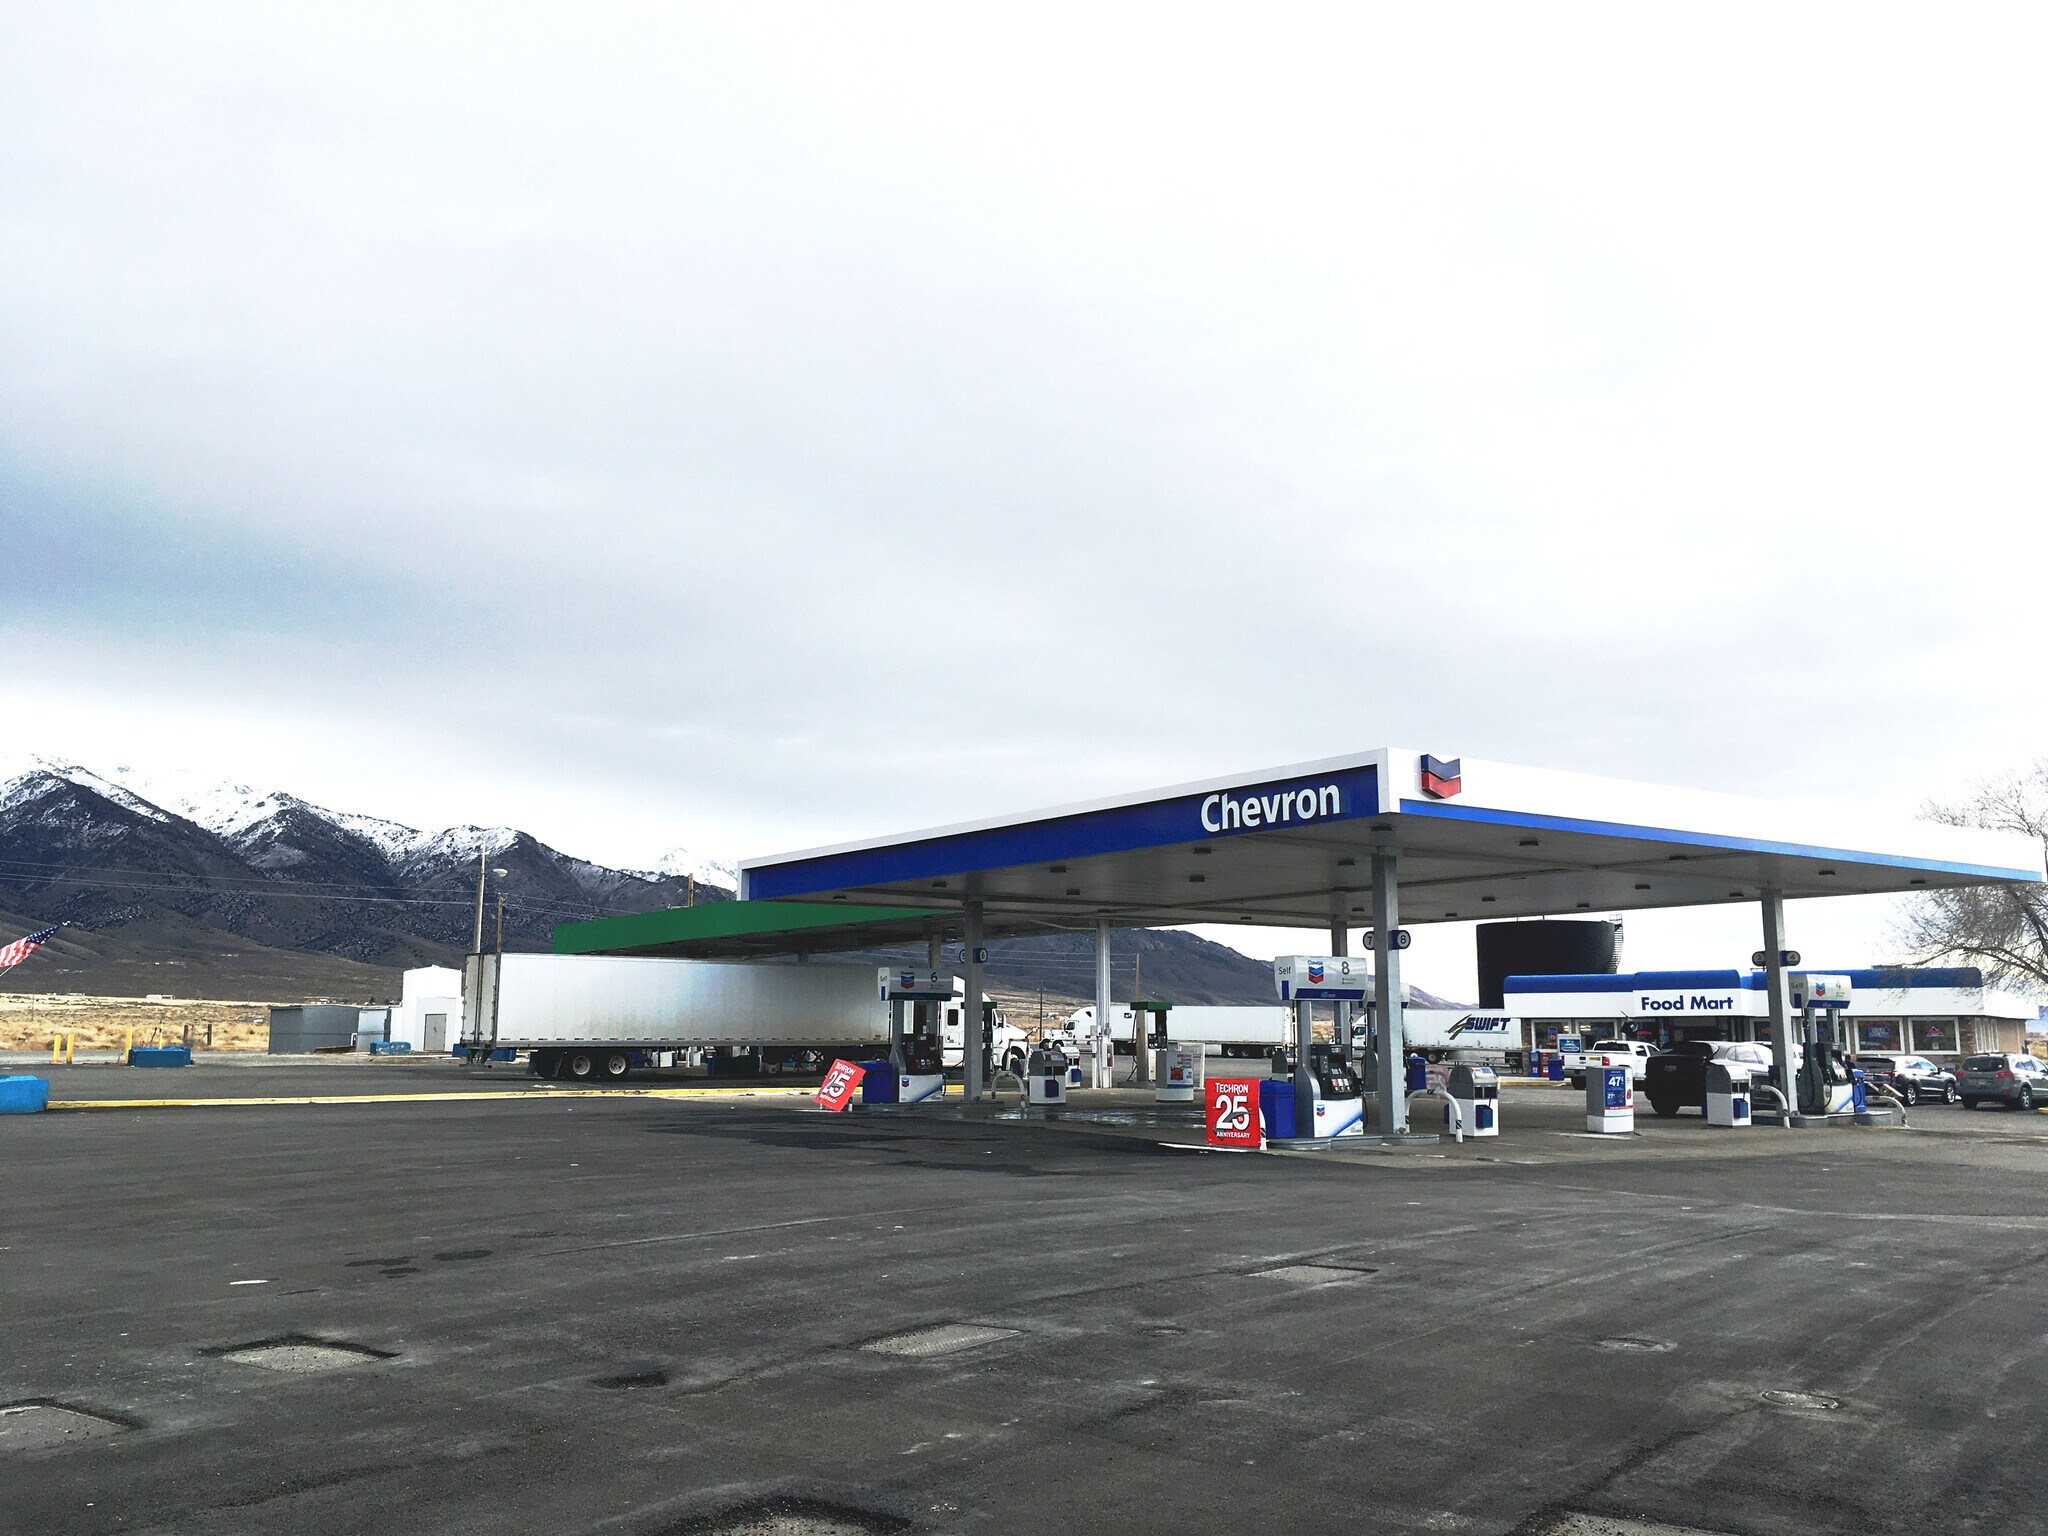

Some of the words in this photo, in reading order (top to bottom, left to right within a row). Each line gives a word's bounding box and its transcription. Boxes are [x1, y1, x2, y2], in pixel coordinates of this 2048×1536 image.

[1201, 784, 1340, 833] Chevron
[1366, 936, 1374, 946] 7
[1400, 935, 1407, 945] 8
[1278, 966, 1291, 975] Self
[1341, 961, 1350, 975] 8
[930, 972, 938, 982] 6
[1790, 982, 1804, 990] Self
[1835, 979, 1842, 990] 4
[1641, 995, 1684, 1010] Food
[1690, 996, 1733, 1010] Mart
[1465, 1017, 1511, 1031] SWIFT
[821, 1070, 851, 1097] 25
[1215, 1082, 1249, 1095] TECHRON
[1216, 1094, 1249, 1130] 25
[1216, 1131, 1251, 1139] ANNIVERSARY
